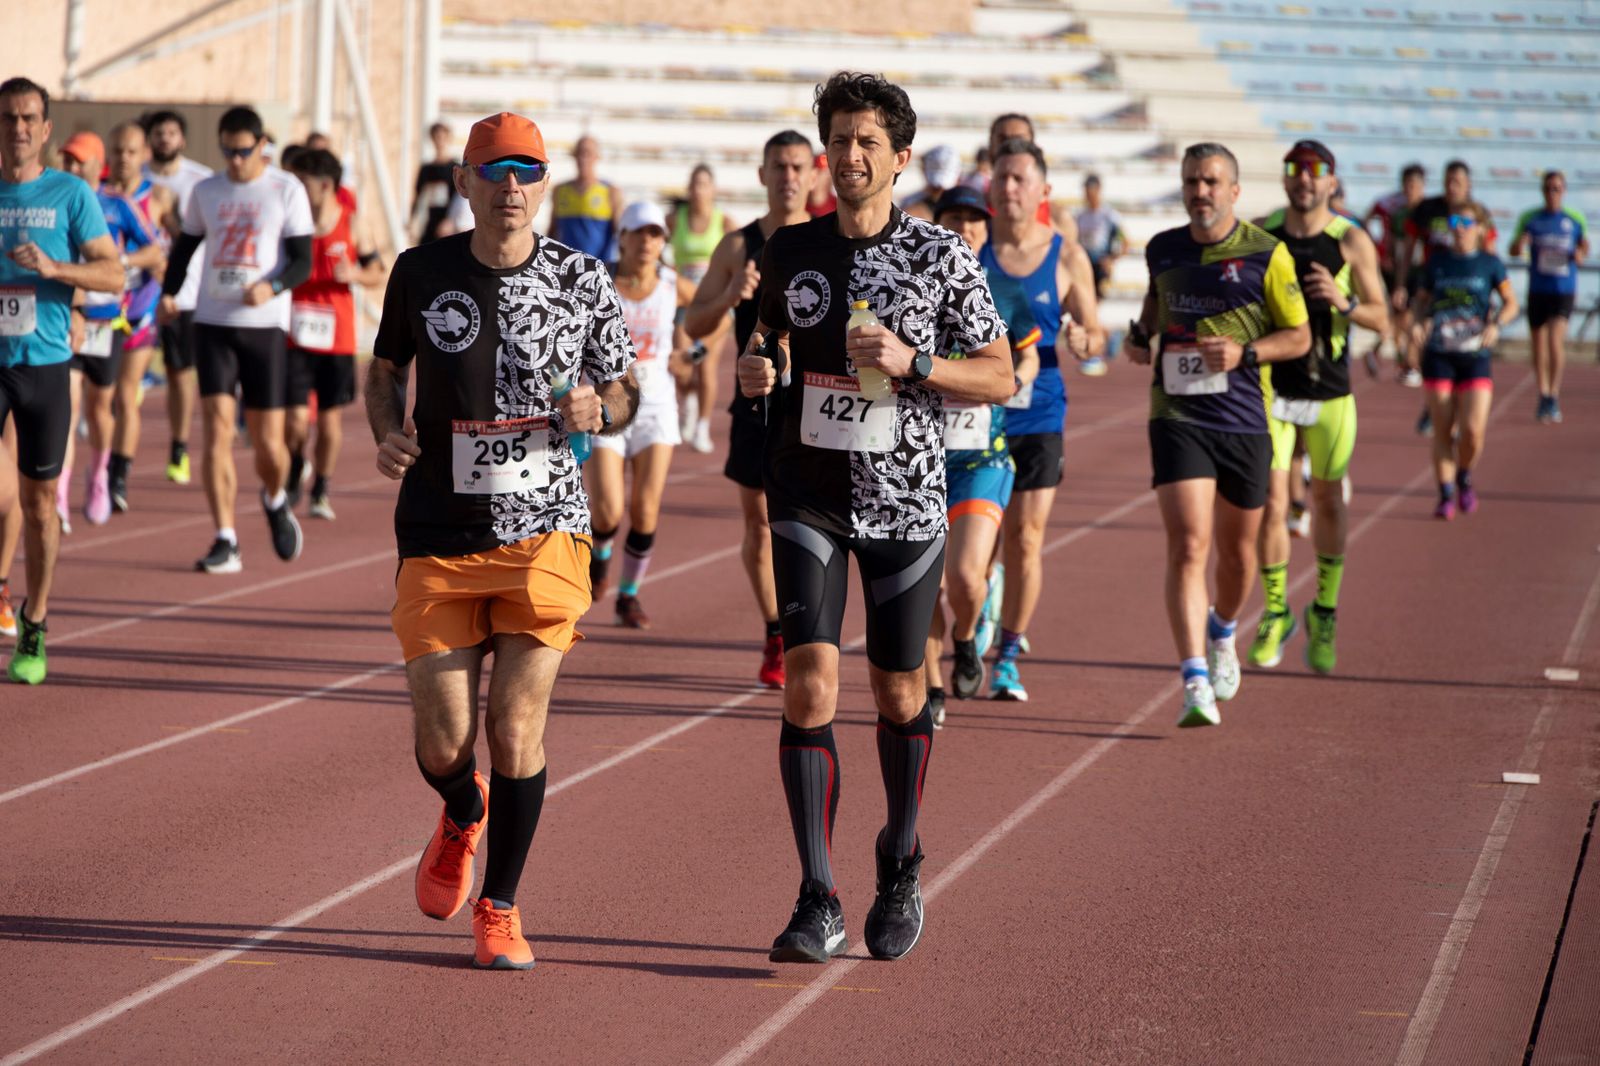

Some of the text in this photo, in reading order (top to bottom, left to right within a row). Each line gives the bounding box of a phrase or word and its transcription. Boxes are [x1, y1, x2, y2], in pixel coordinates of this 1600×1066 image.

[435, 292, 479, 351] TIGERS RUNNING CLUB
[1177, 356, 1203, 375] 82
[804, 374, 834, 387] XXXVI
[819, 393, 874, 423] 427
[454, 422, 487, 433] XXXVI
[473, 437, 528, 466] 295
